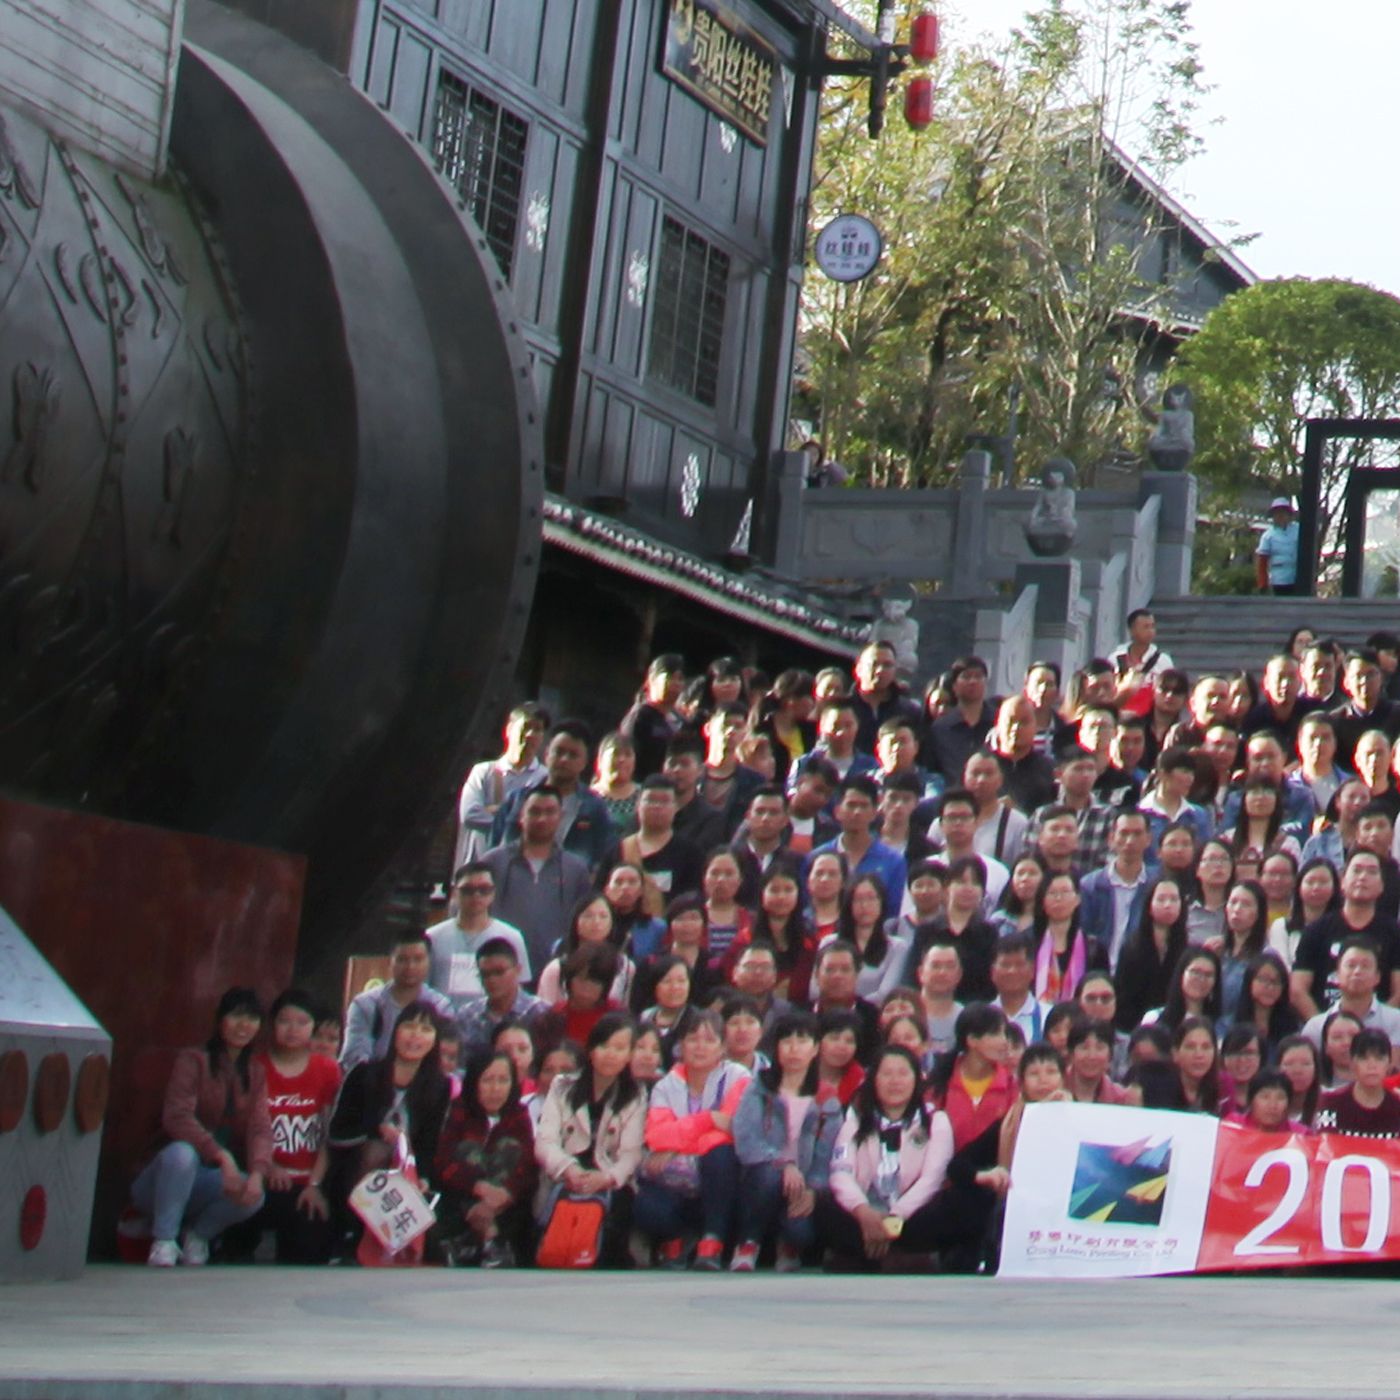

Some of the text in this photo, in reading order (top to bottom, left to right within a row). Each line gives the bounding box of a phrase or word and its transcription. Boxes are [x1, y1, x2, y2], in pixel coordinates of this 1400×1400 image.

[690, 9, 772, 123] 贵阳丝娃娃
